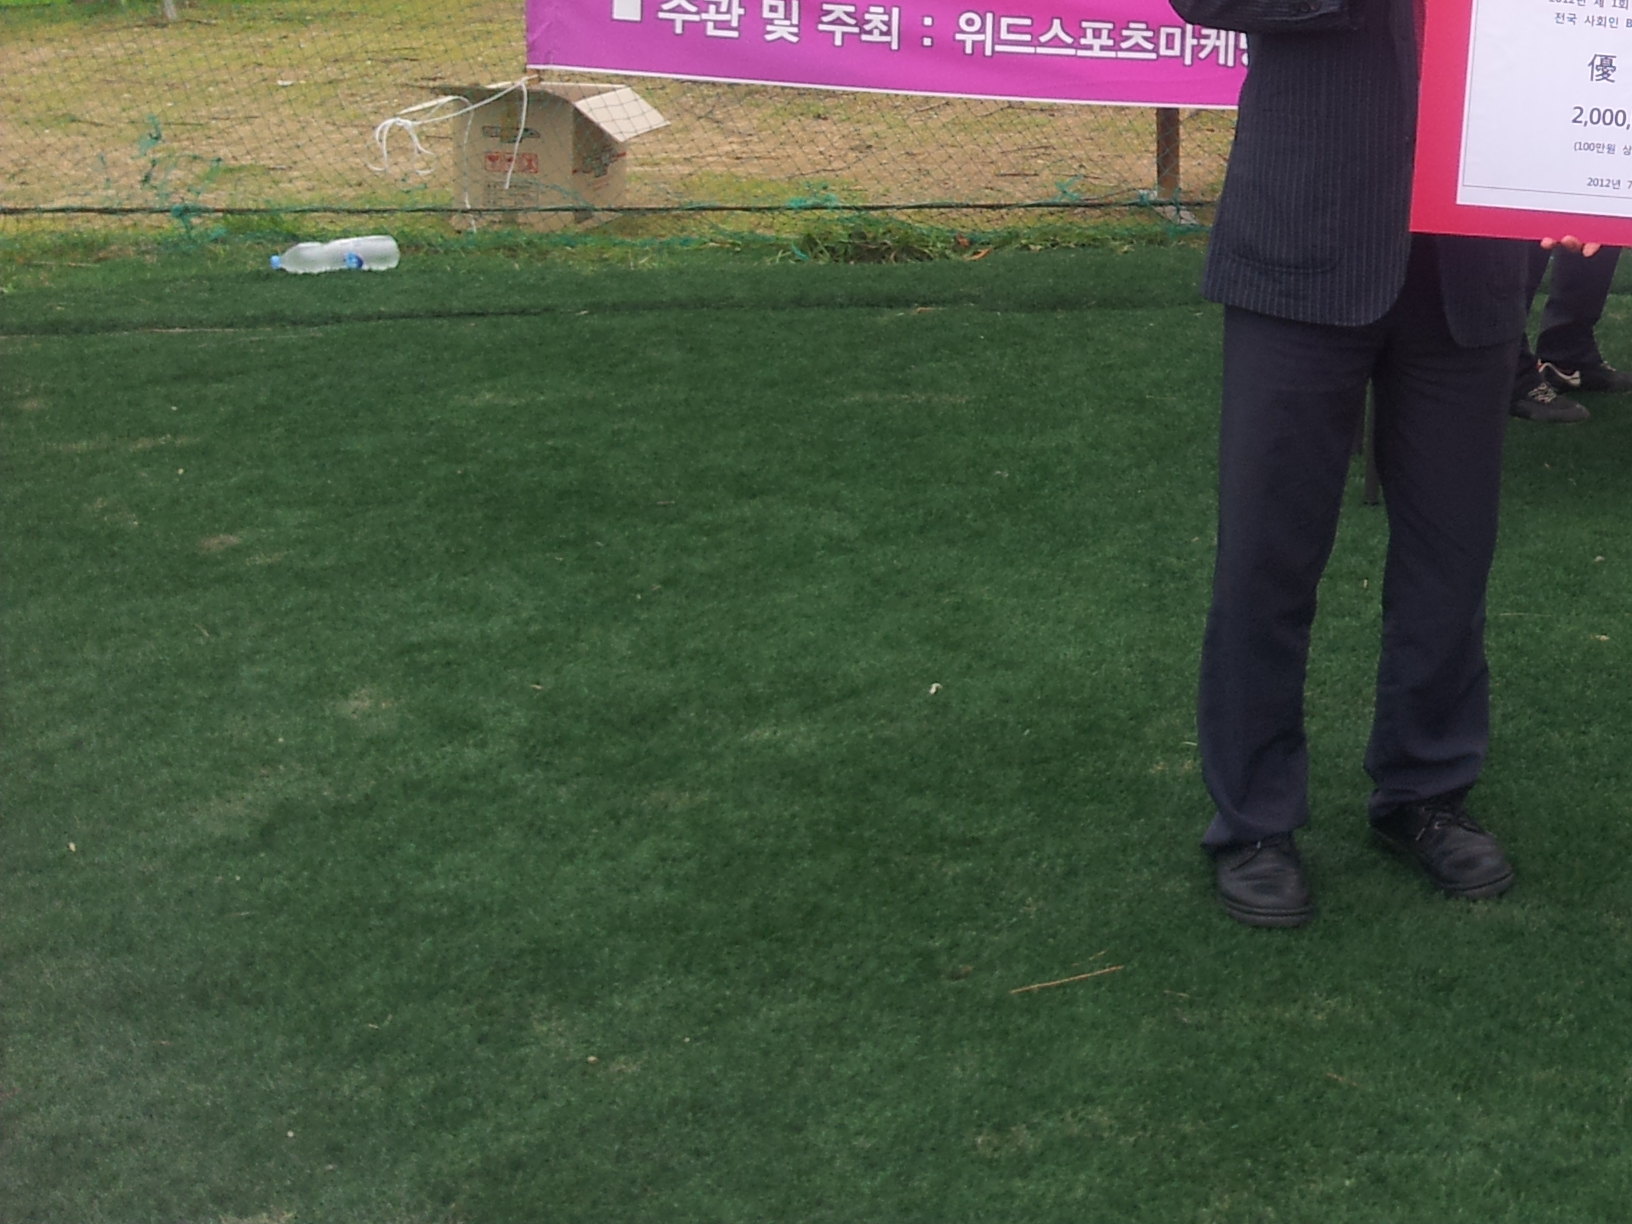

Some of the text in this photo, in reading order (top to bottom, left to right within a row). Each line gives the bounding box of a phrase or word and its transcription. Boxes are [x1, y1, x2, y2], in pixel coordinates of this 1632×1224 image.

[761, 0, 800, 43] 및
[817, 3, 901, 51] 주최
[1554, 12, 1577, 25] 전국
[1584, 15, 1619, 28] 사회인
[1573, 141, 1616, 155] (100만원
[1586, 177, 1622, 190] 2012년
